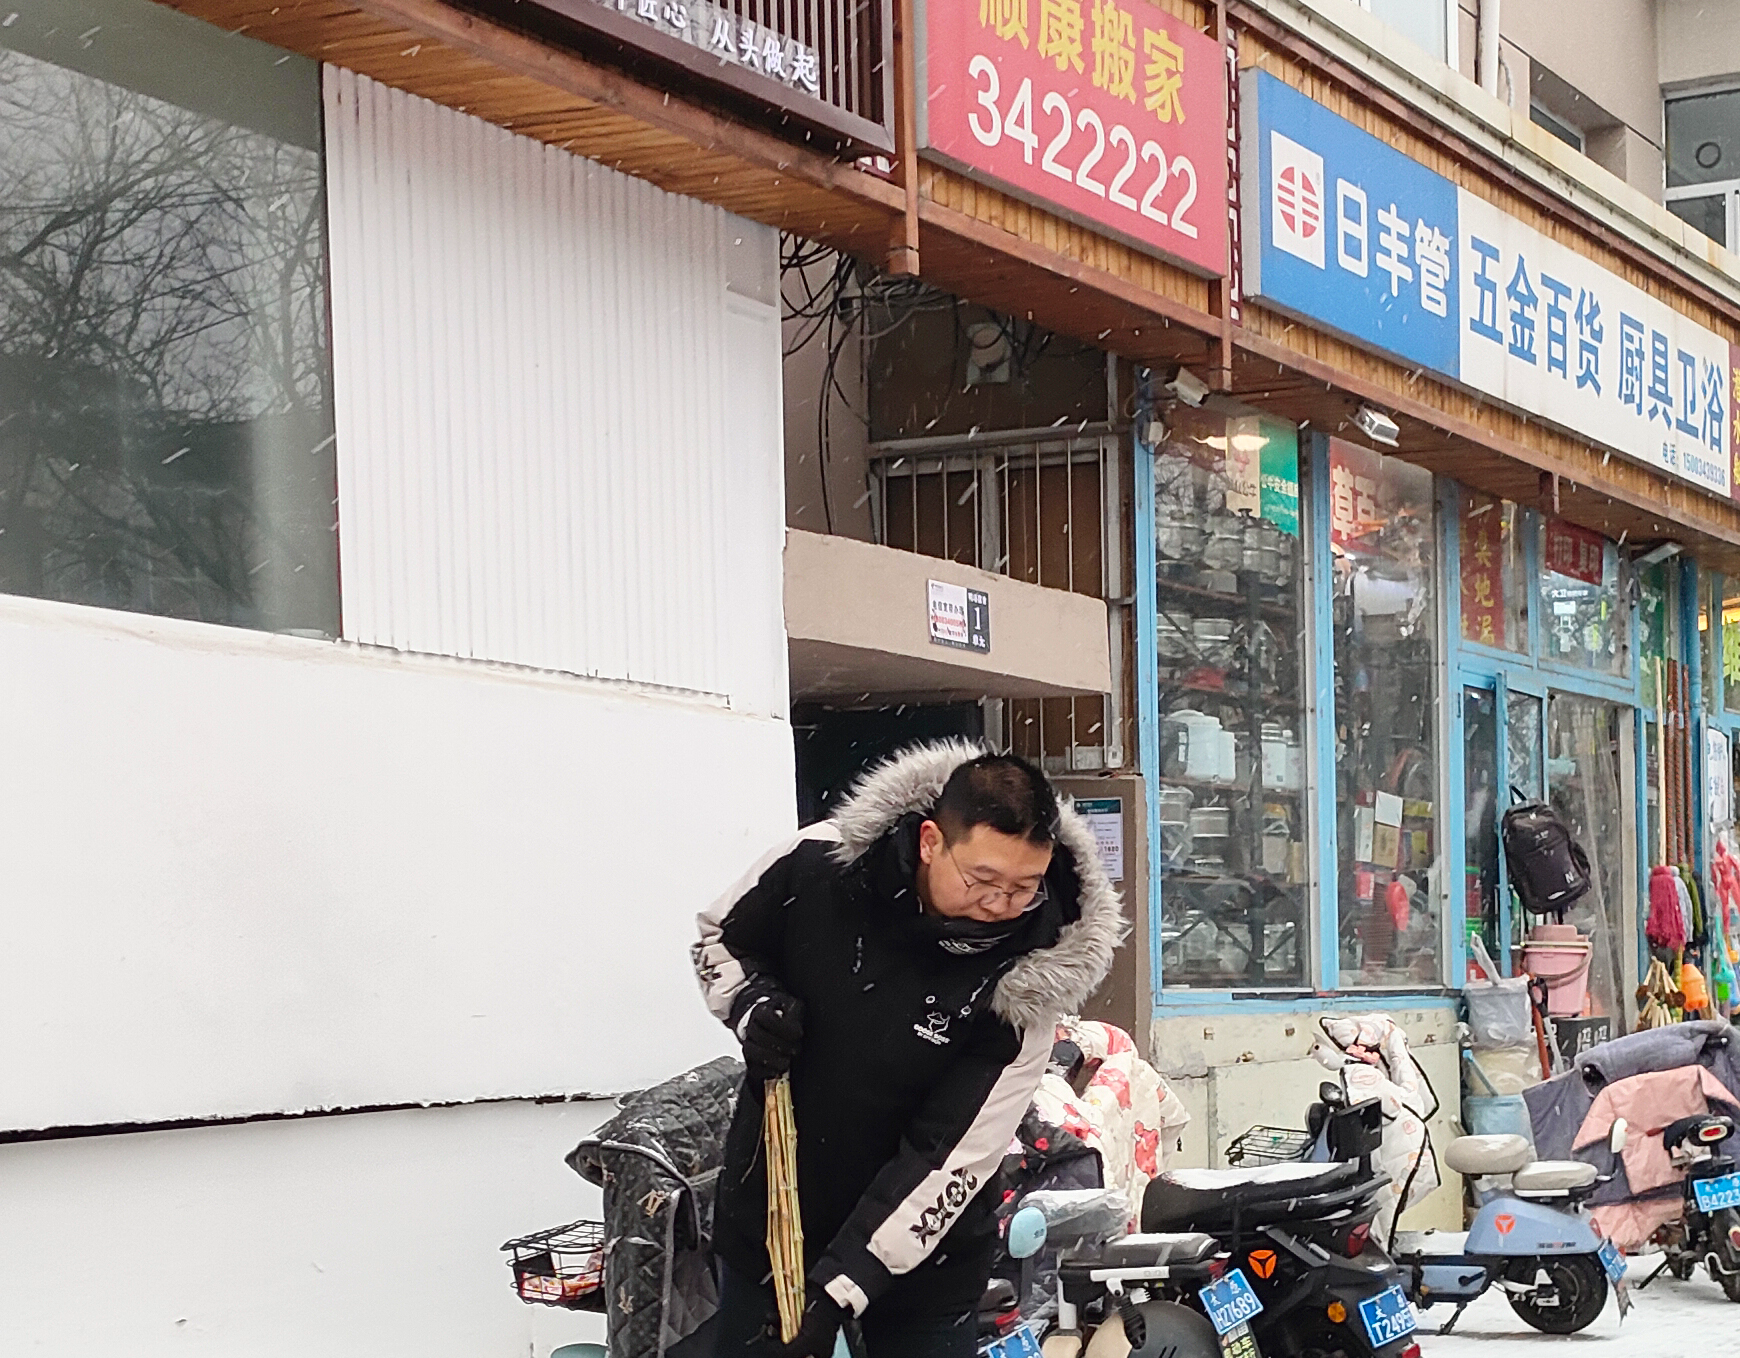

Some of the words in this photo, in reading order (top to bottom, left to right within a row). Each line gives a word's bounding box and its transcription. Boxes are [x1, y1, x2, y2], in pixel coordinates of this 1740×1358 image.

[711, 17, 820, 92] 从头做起
[979, 0, 1186, 125] 顺康搬家
[967, 54, 1198, 240] 3422222
[1335, 176, 1450, 318] 日丰管
[1469, 234, 1604, 397] 五金百货
[1618, 311, 1726, 456] 厨具卫浴
[974, 606, 981, 631] 1
